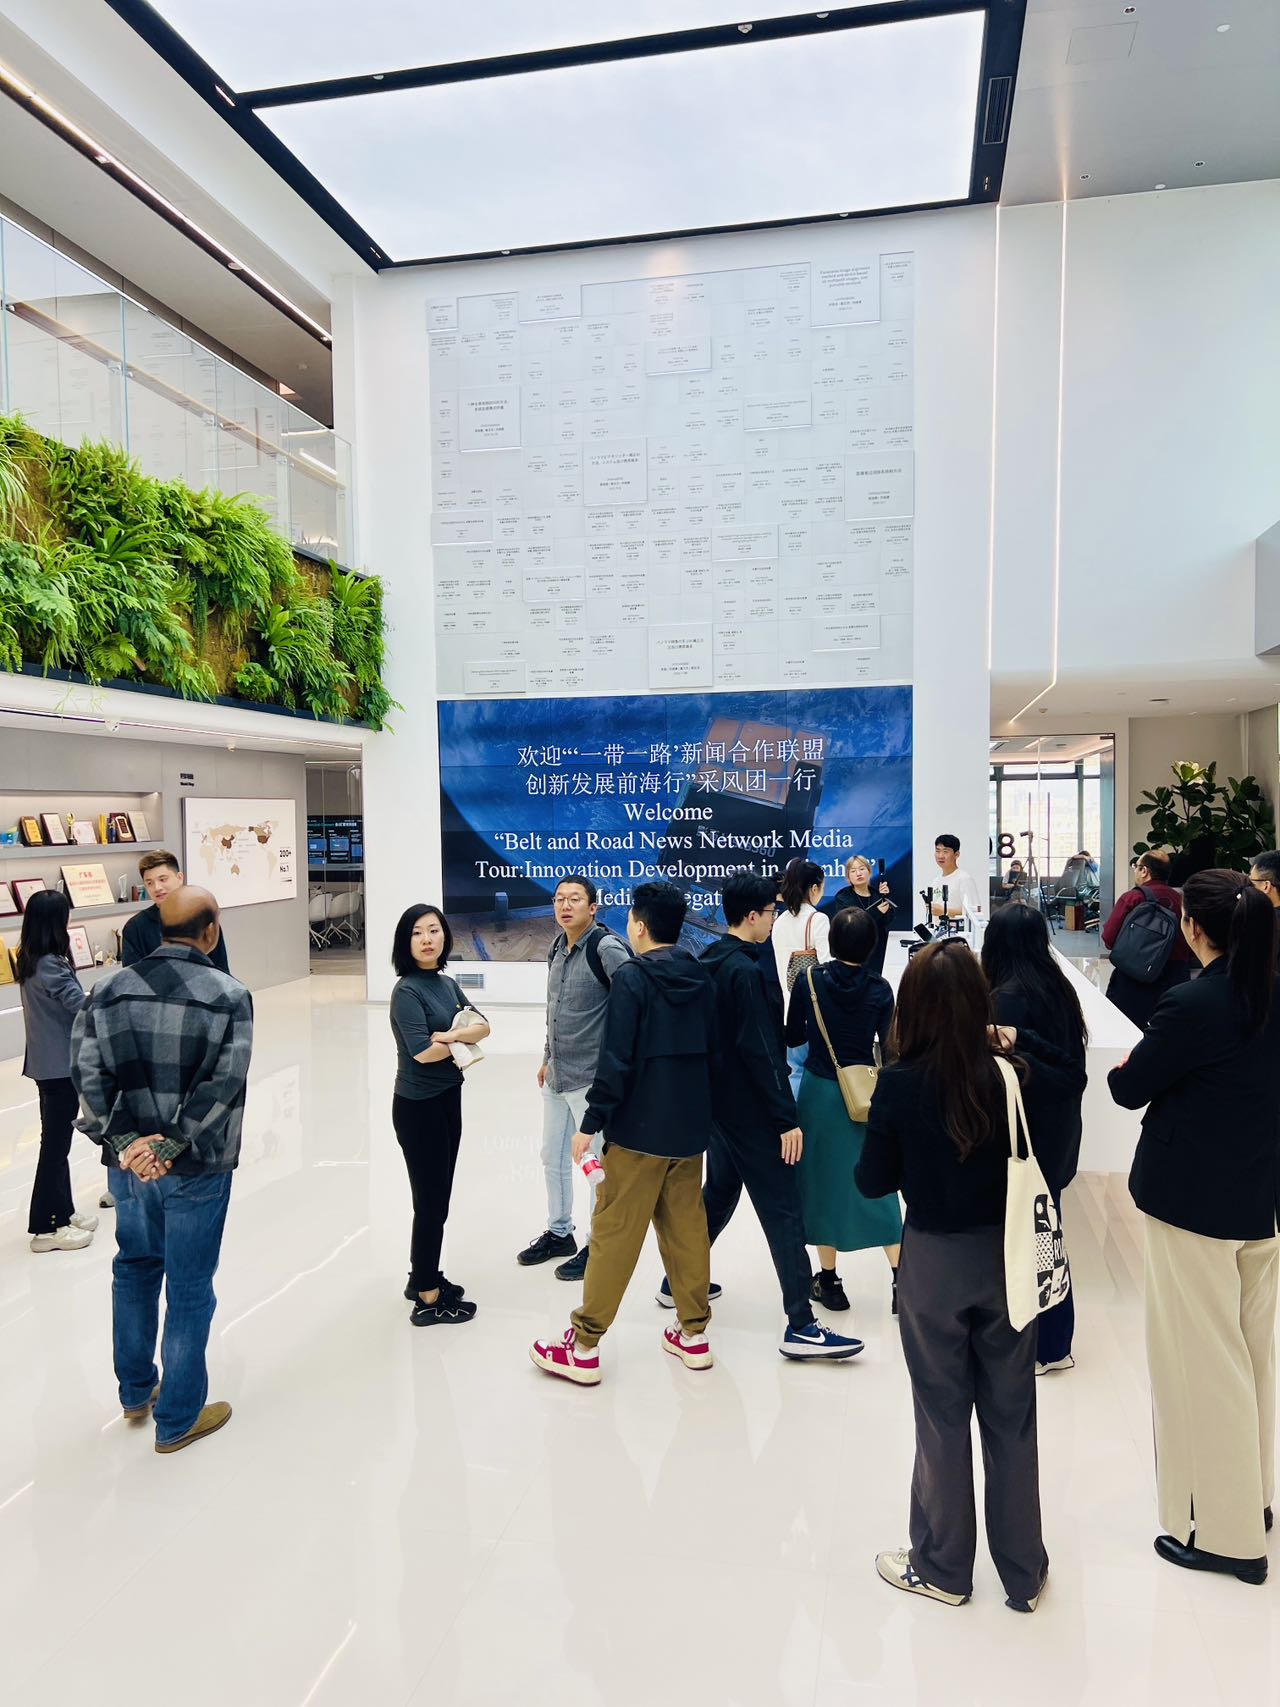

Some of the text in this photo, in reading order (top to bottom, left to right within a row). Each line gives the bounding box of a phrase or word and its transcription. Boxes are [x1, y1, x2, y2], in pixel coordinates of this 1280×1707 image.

[525, 768, 817, 795] 创新发展前海行”采风团一行
[624, 803, 713, 821] Welcome
[494, 832, 542, 850] “Belt
[547, 832, 580, 850] and
[585, 831, 634, 850] Road
[639, 831, 693, 850] News
[699, 830, 784, 849] Network
[789, 829, 853, 849] Media
[475, 860, 622, 878] Tour:Innovation
[762, 859, 779, 878] in
[596, 888, 635, 906] edi
